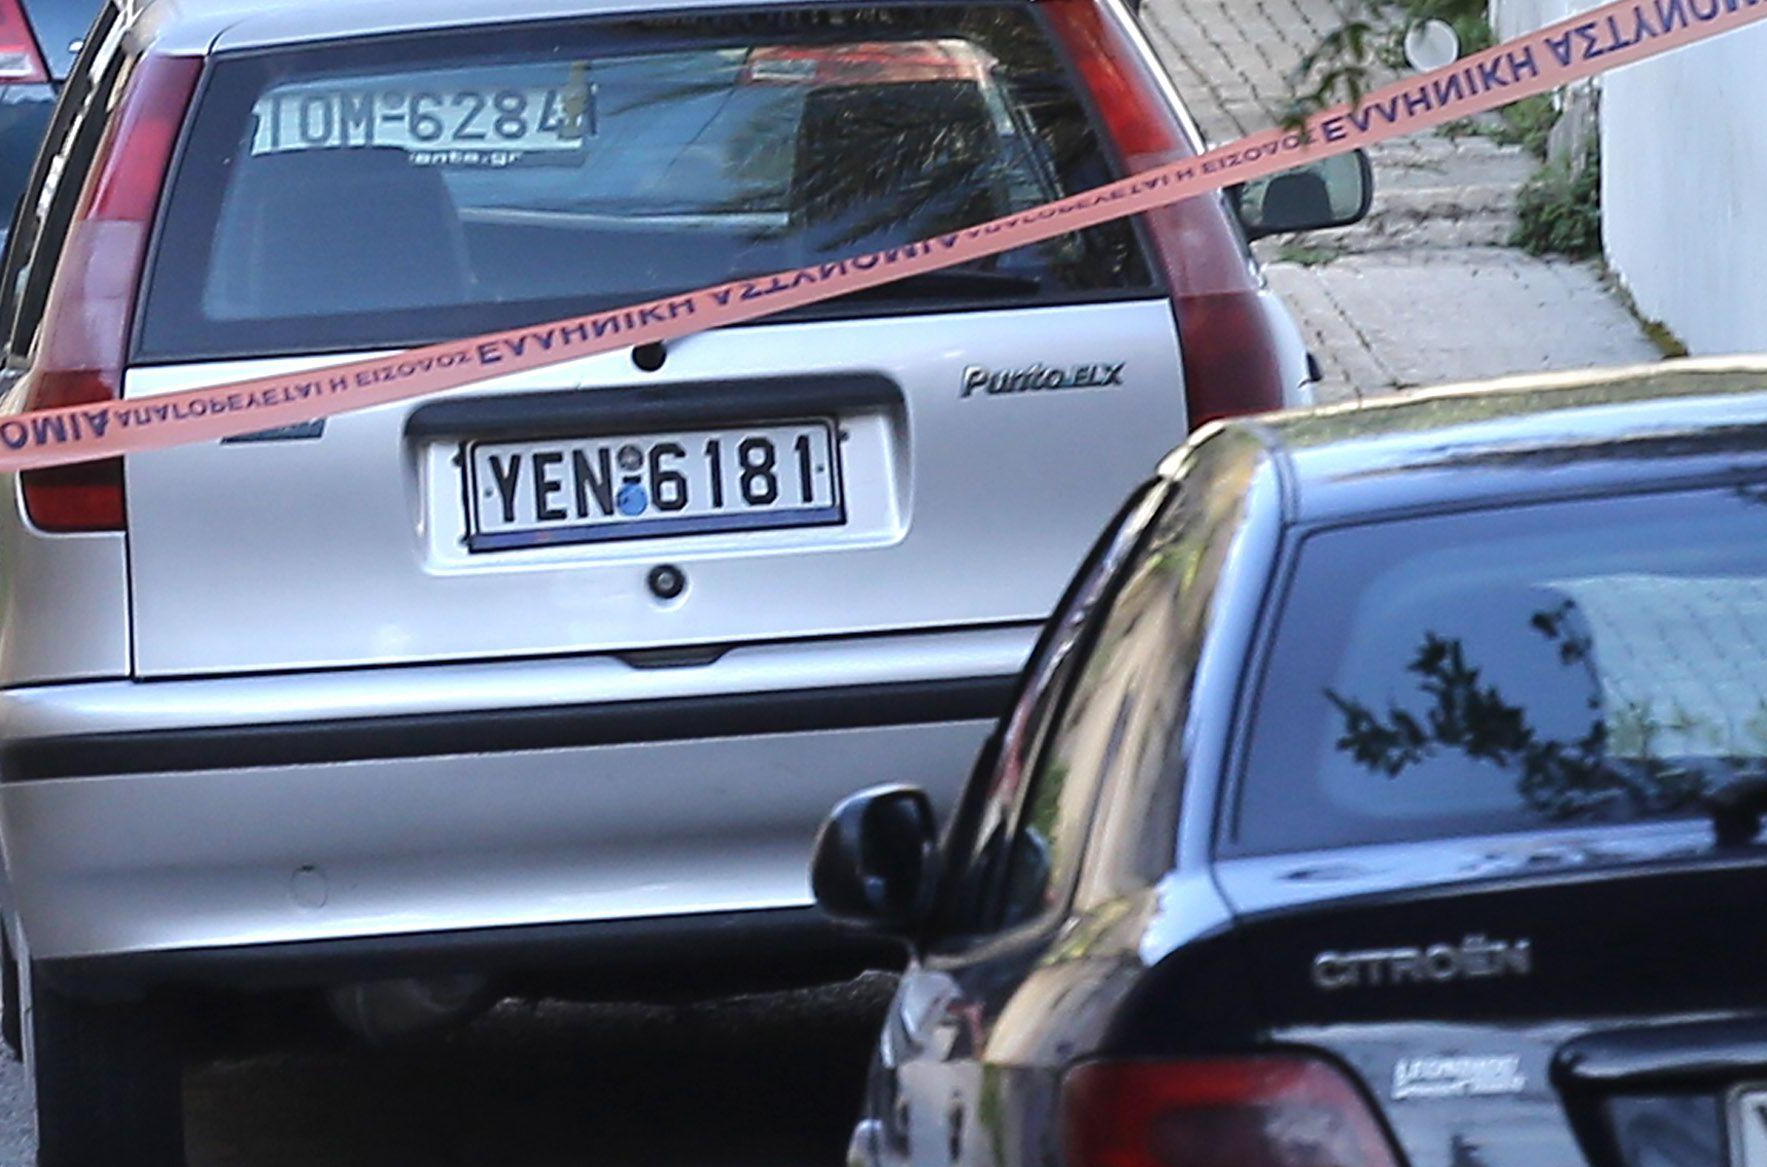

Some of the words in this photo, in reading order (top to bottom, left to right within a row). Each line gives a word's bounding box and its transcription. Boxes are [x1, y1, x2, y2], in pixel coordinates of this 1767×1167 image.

[960, 365, 1066, 398] Punto
[1072, 363, 1125, 388] ELX
[1314, 933, 1532, 988] CITROËN
